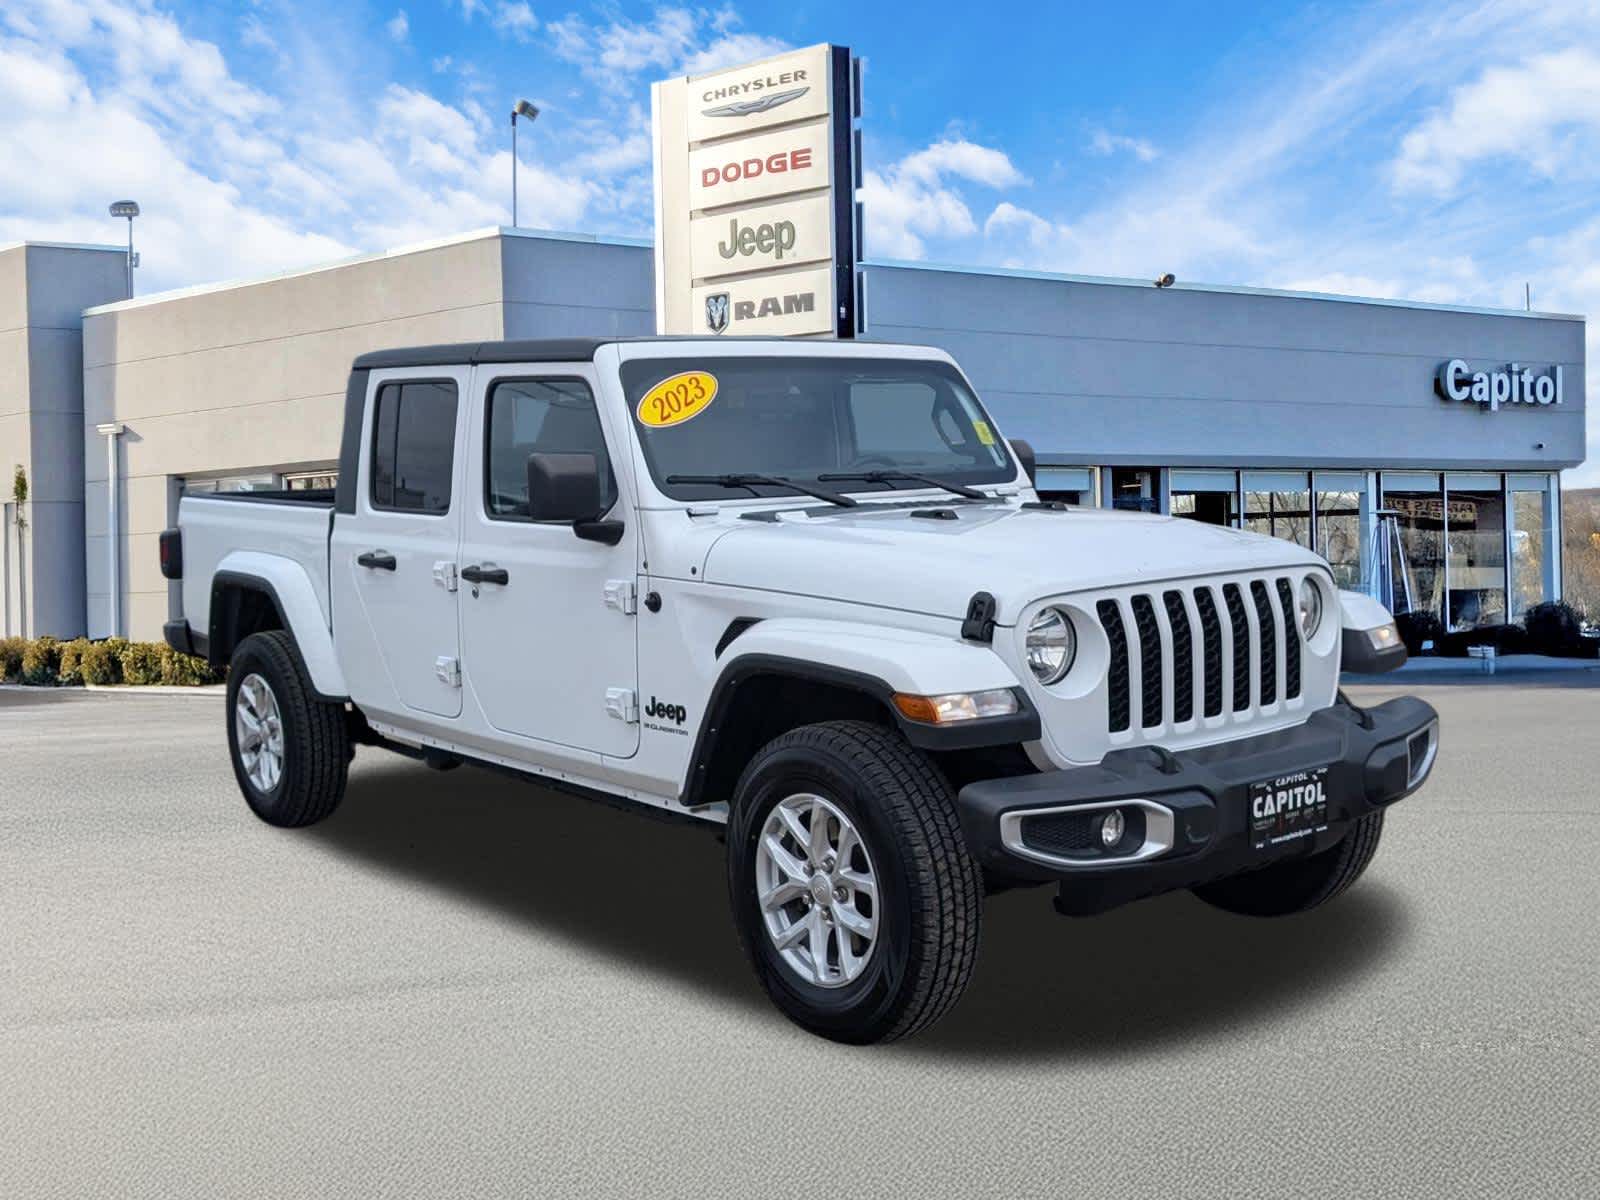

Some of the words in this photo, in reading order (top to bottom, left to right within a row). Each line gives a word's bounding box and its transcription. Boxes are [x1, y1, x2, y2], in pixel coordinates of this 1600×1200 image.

[702, 69, 808, 103] CHRYSLER
[702, 147, 812, 188] DODGE
[718, 218, 796, 260] Jeep
[734, 292, 815, 321] RAM
[652, 376, 706, 422] 2023
[1445, 358, 1563, 412] Capitol
[645, 695, 687, 726] Jeep
[1275, 772, 1309, 787] CAPITOL
[1252, 781, 1326, 818] CAPITOL
